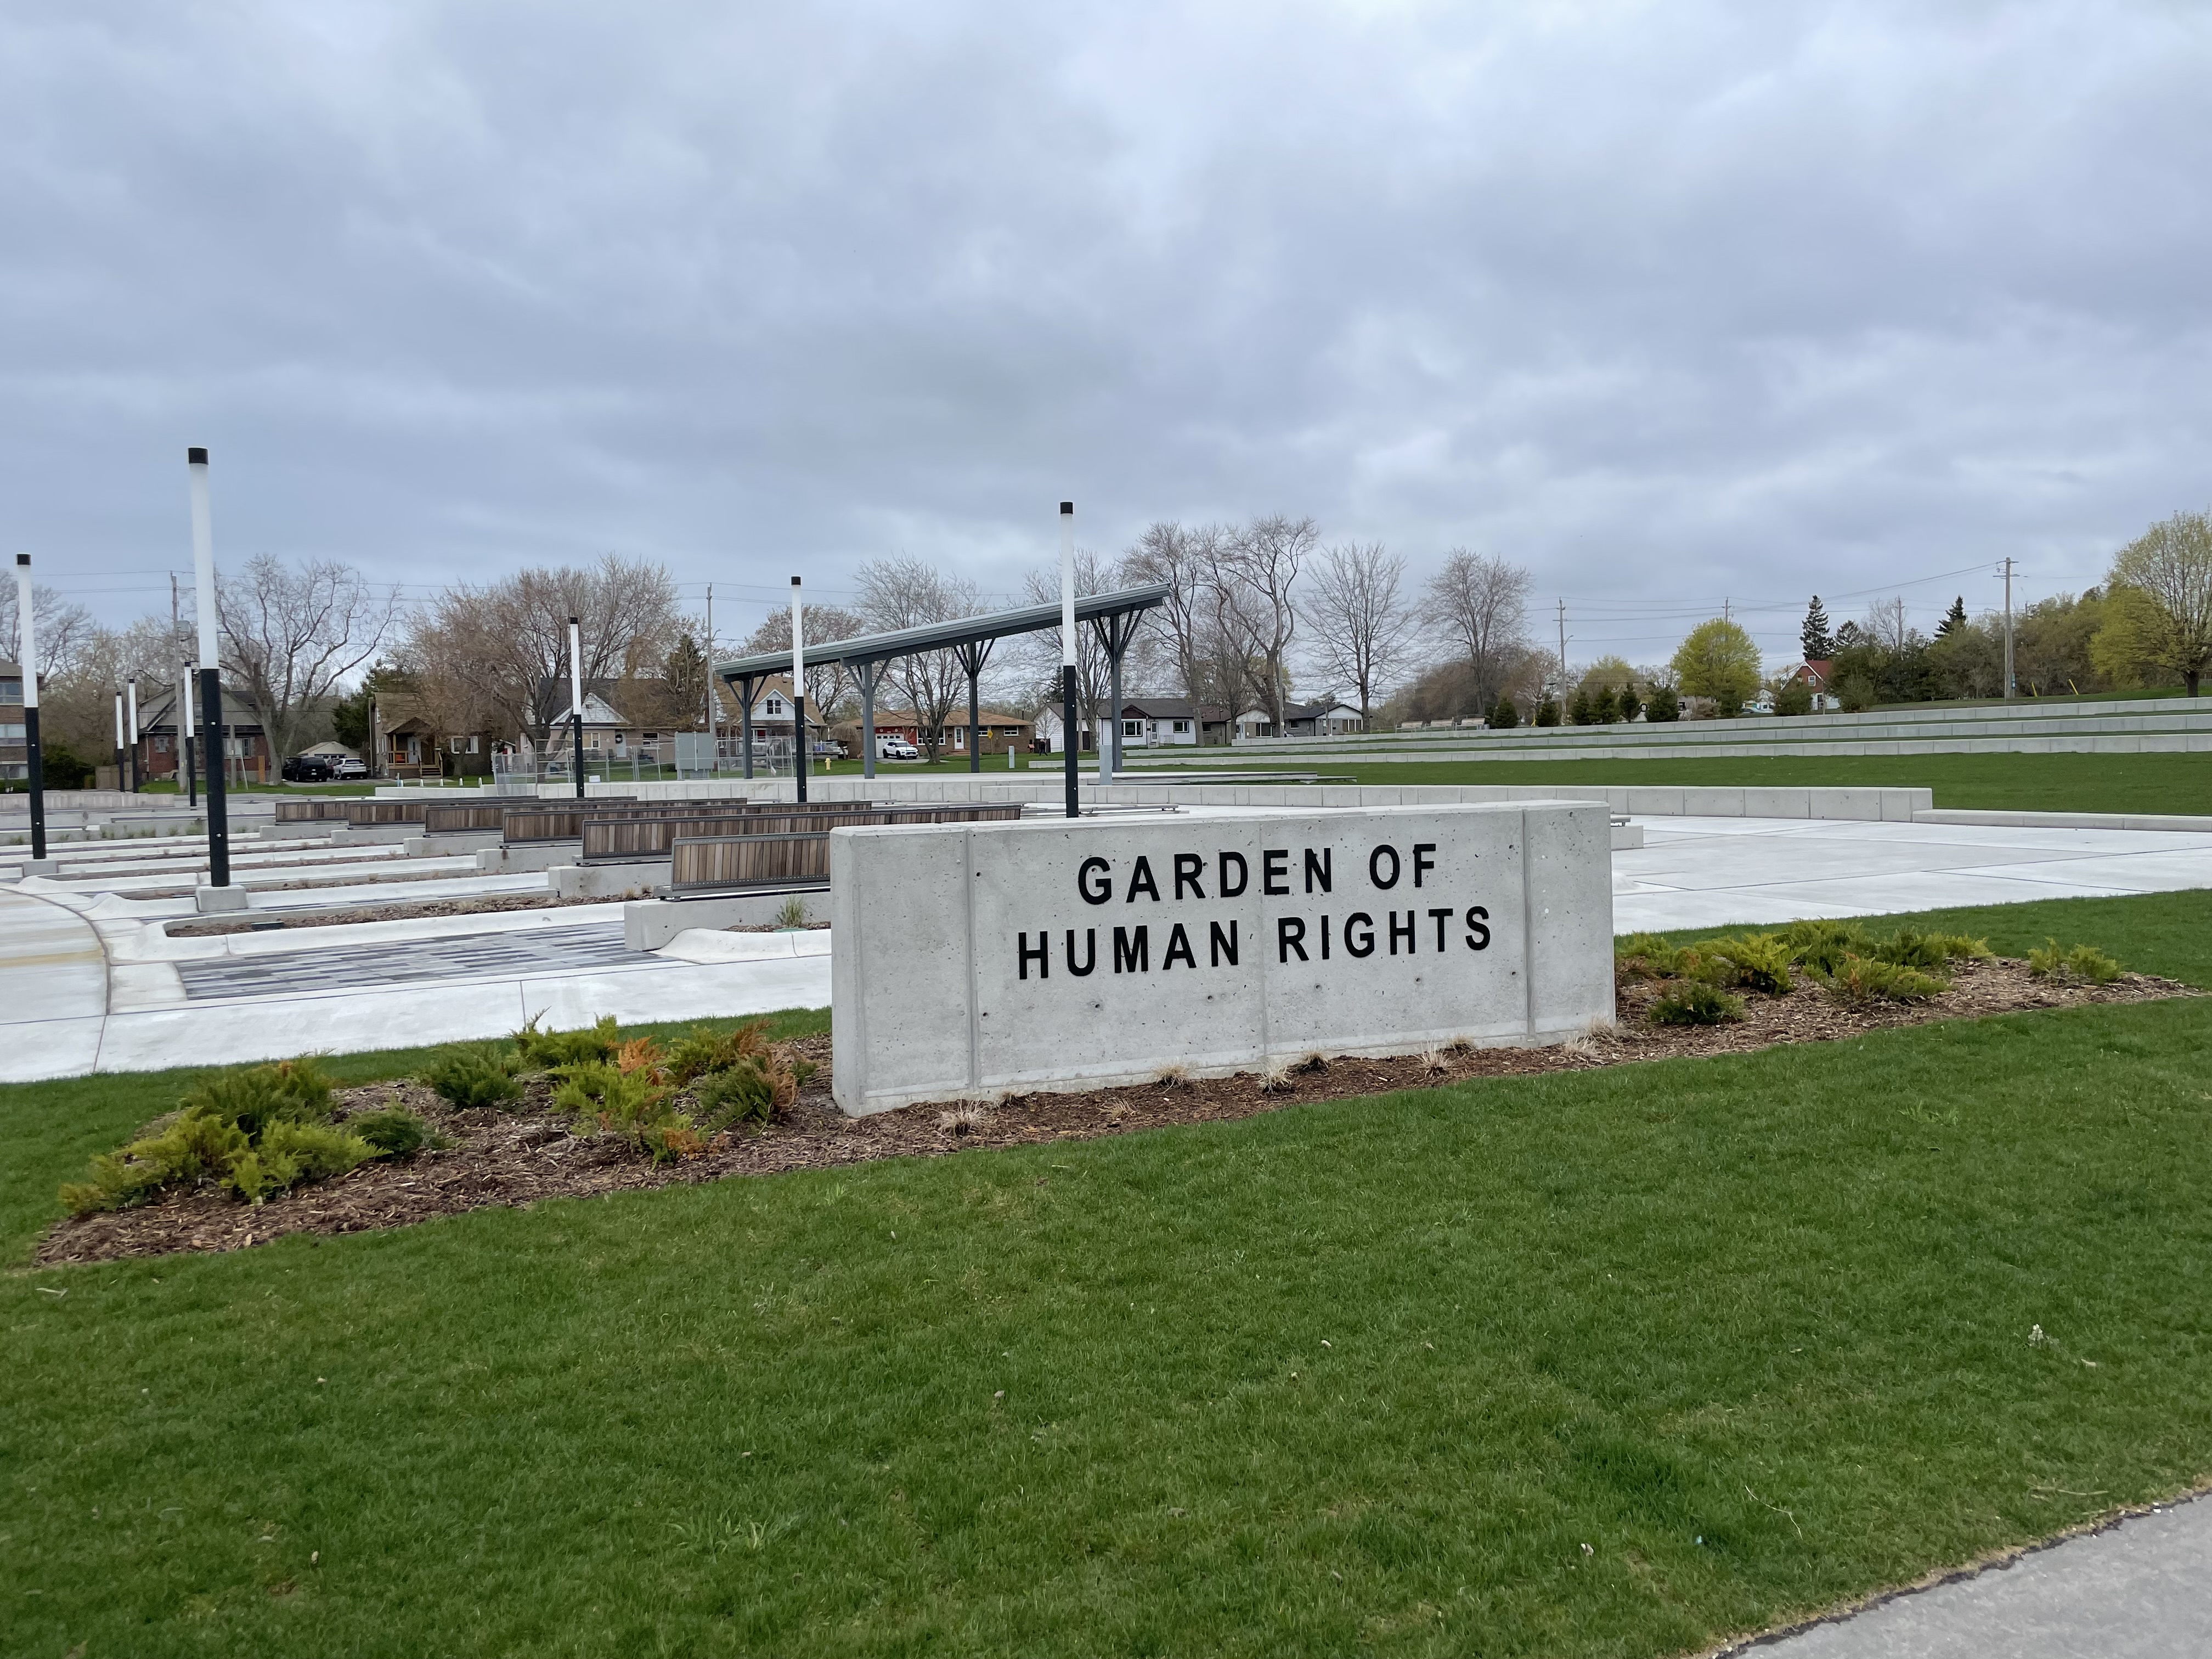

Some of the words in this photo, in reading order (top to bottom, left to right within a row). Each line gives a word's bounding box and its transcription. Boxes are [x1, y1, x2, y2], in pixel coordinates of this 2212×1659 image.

[1077, 847, 1332, 905] GARDEN
[1369, 843, 1436, 890] OF
[1018, 919, 1239, 980] HUMAN
[1277, 906, 1491, 963] RIGHTS
